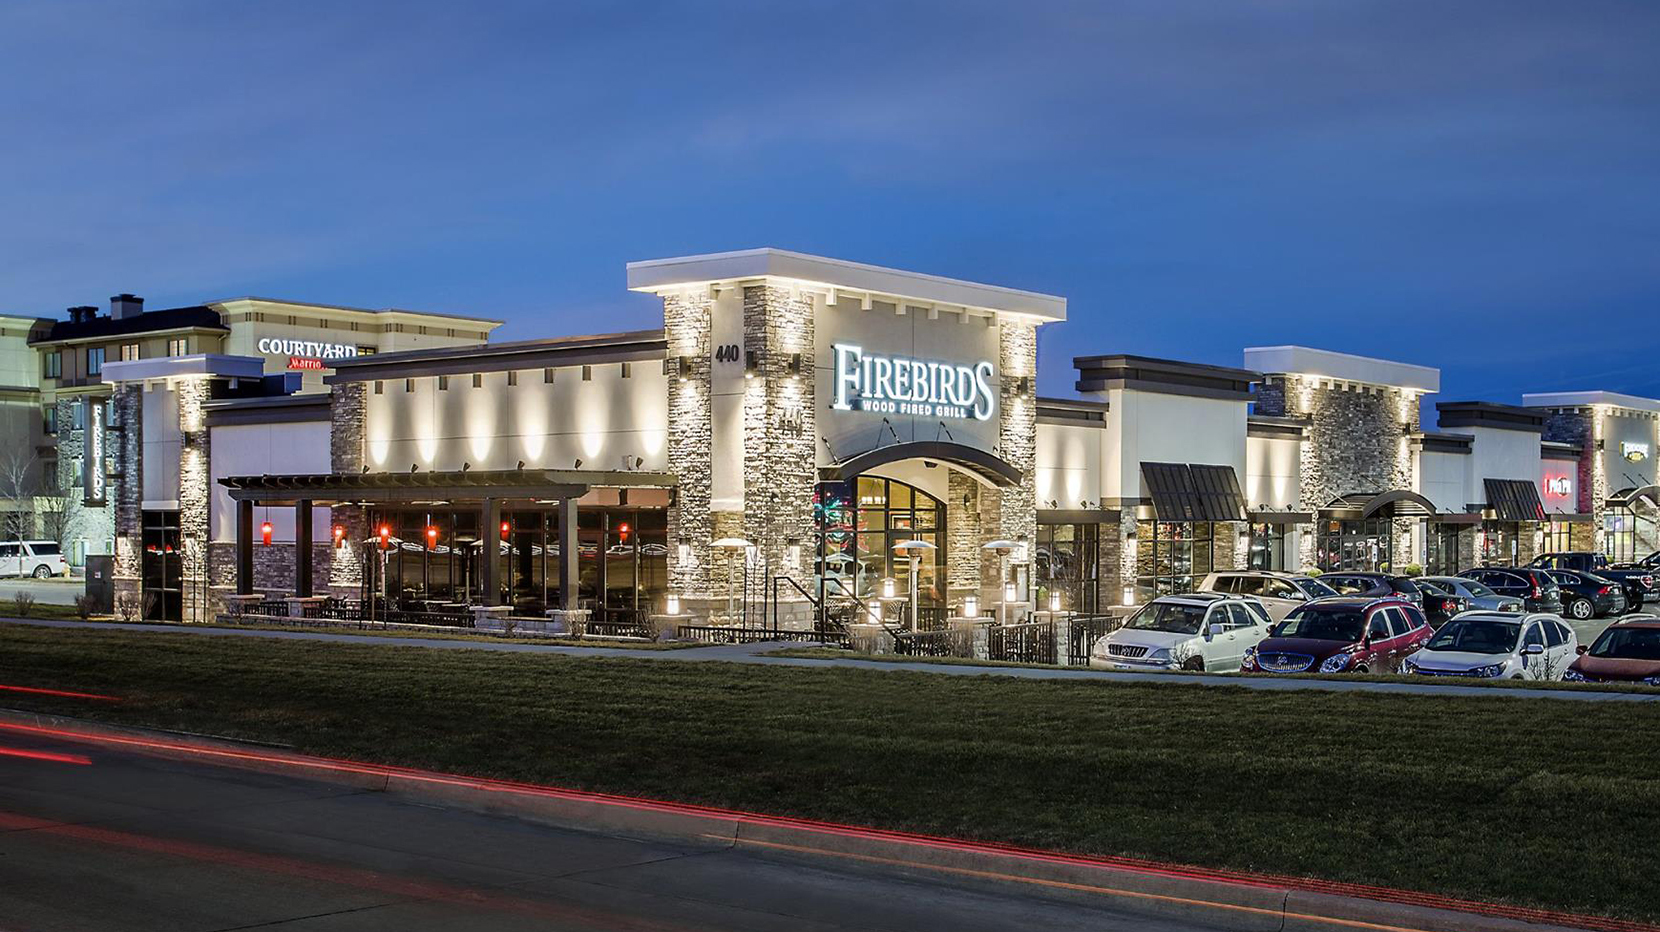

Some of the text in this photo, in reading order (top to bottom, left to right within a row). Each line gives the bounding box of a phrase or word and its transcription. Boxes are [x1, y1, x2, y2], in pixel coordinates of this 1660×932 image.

[258, 338, 357, 358] COURTYARD
[715, 344, 740, 362] 440
[287, 356, 329, 370] Marrio
[833, 343, 994, 421] FIREBIRDS
[863, 400, 967, 418] WOOD FIRED GRILL
[93, 404, 103, 499] FIREBIRDS
